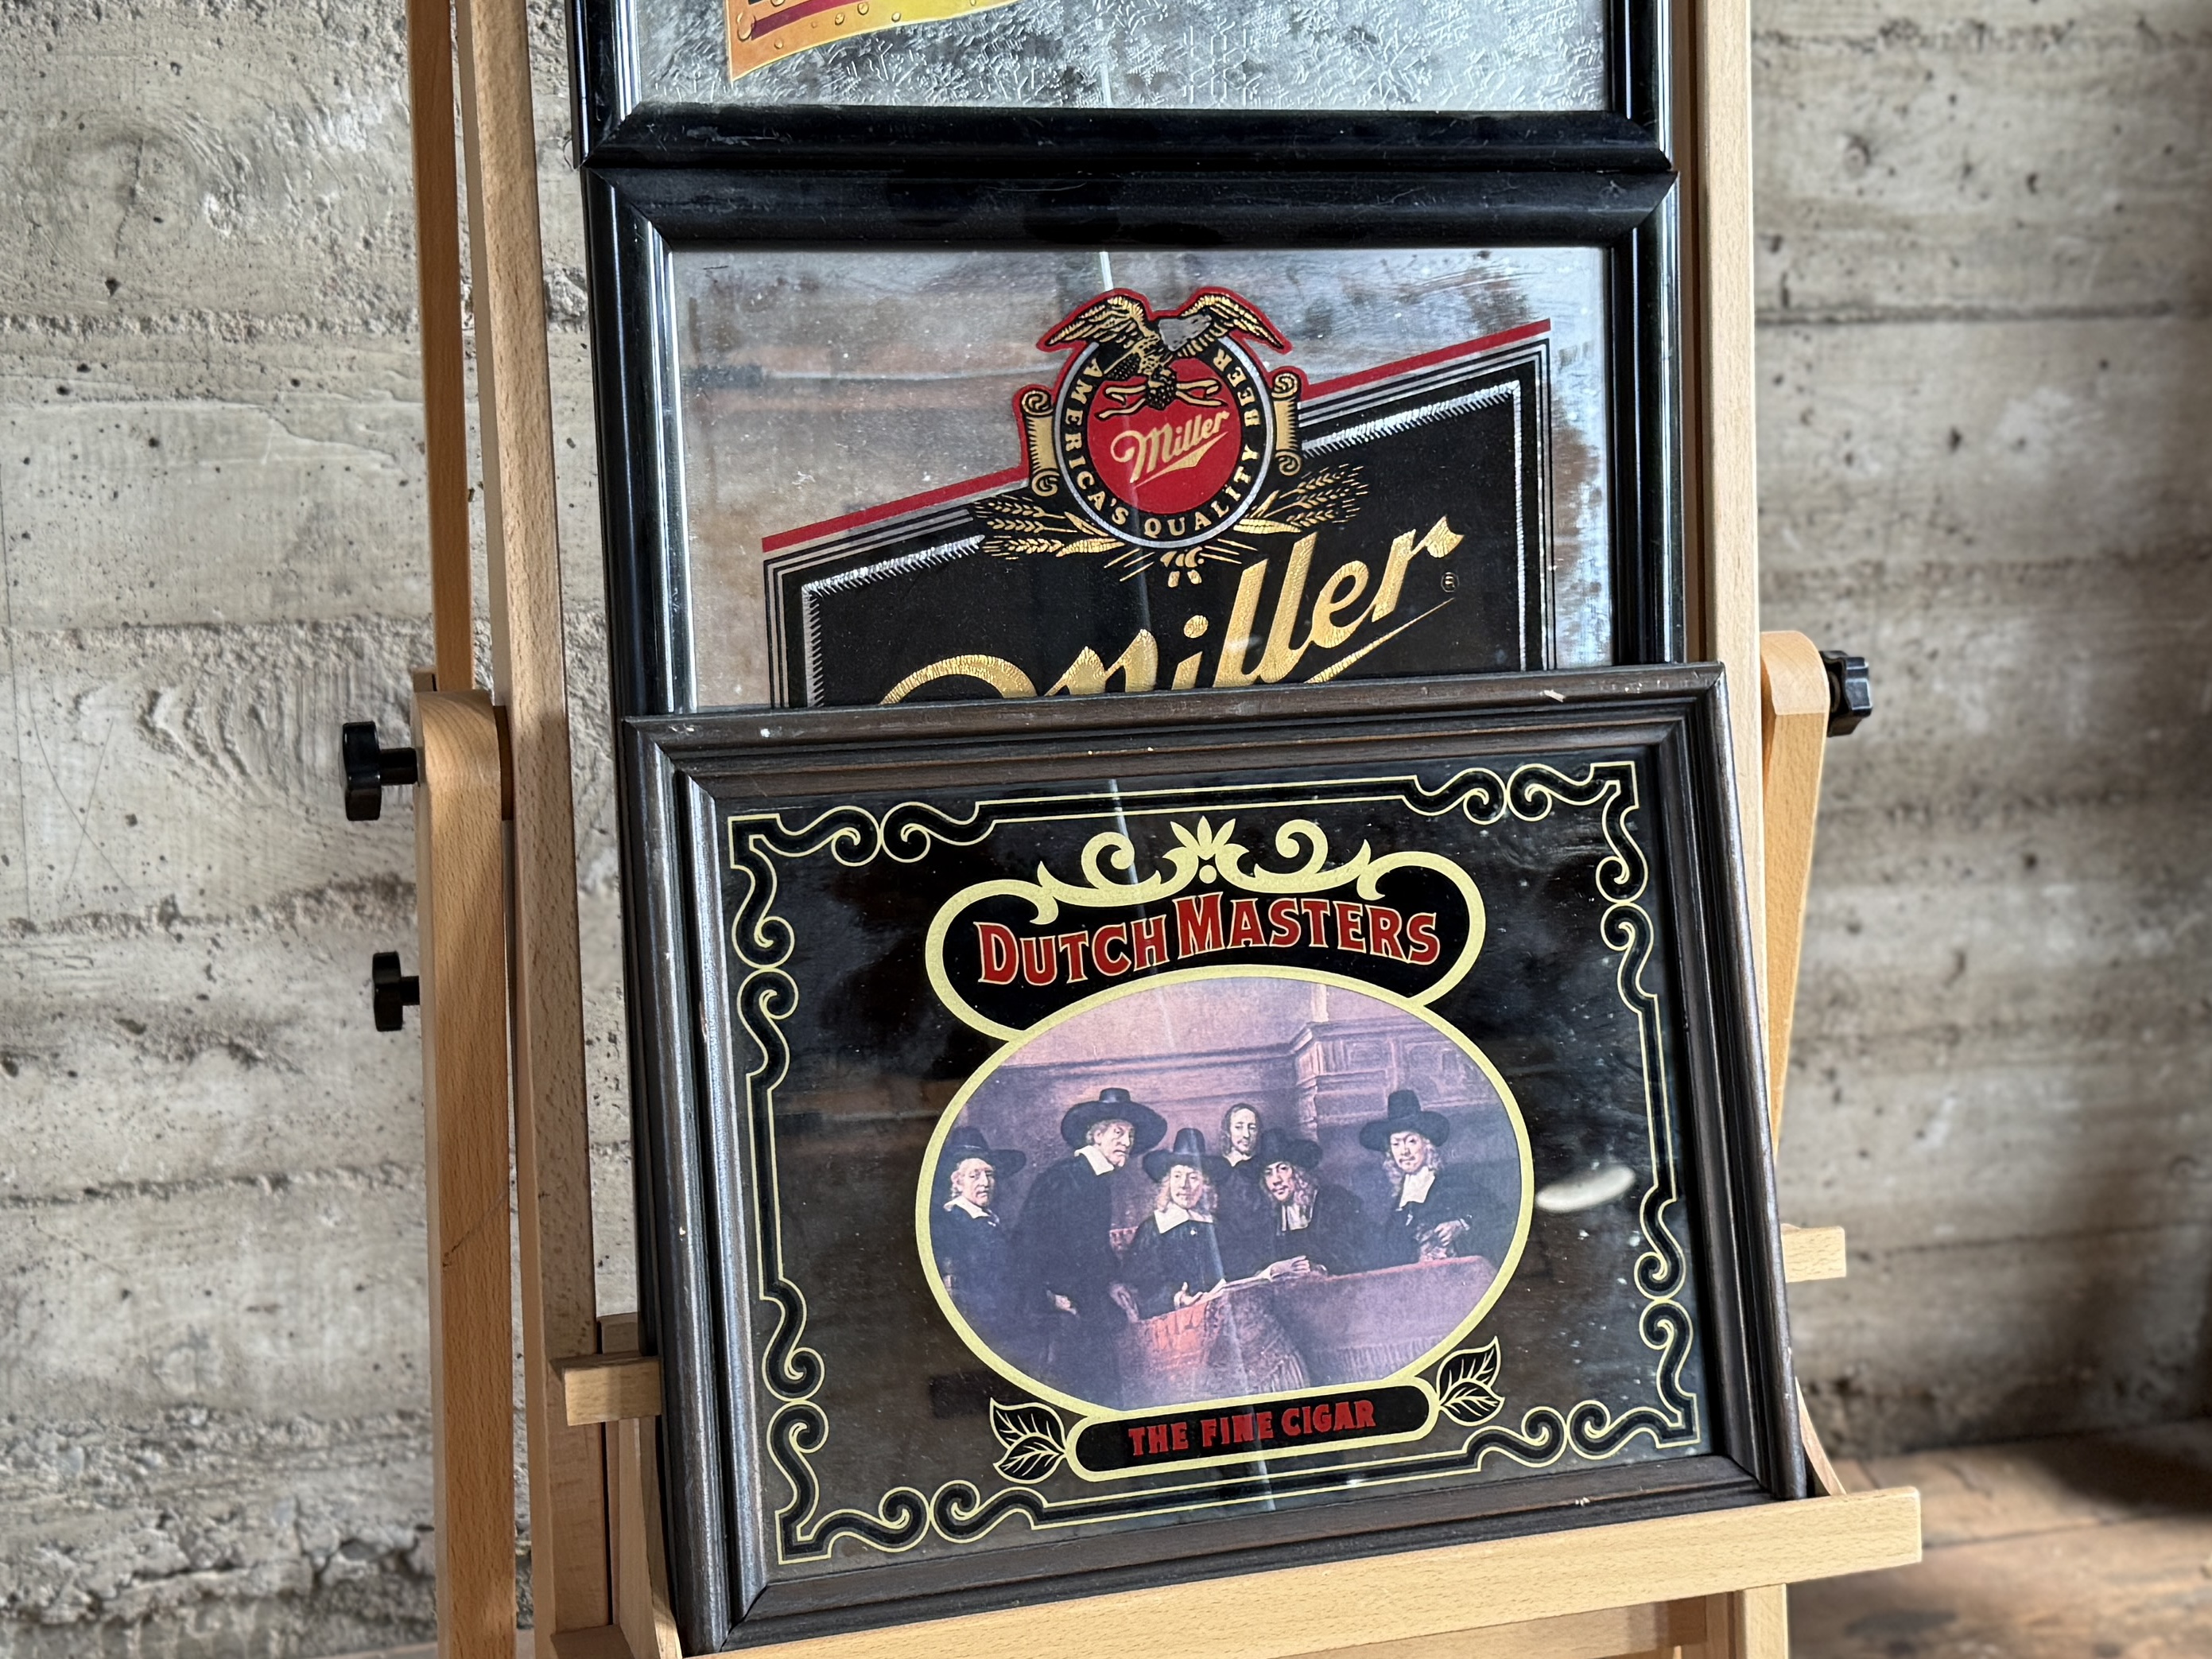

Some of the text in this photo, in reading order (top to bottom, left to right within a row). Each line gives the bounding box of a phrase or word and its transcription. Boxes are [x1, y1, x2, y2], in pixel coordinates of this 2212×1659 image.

[1065, 348, 1261, 538] AMERICA'S QUALITY BEER
[1110, 410, 1230, 484] Miller
[972, 892, 1442, 986] DUTCH MASTERS
[1128, 1400, 1377, 1457] THE FINE CIGAR
